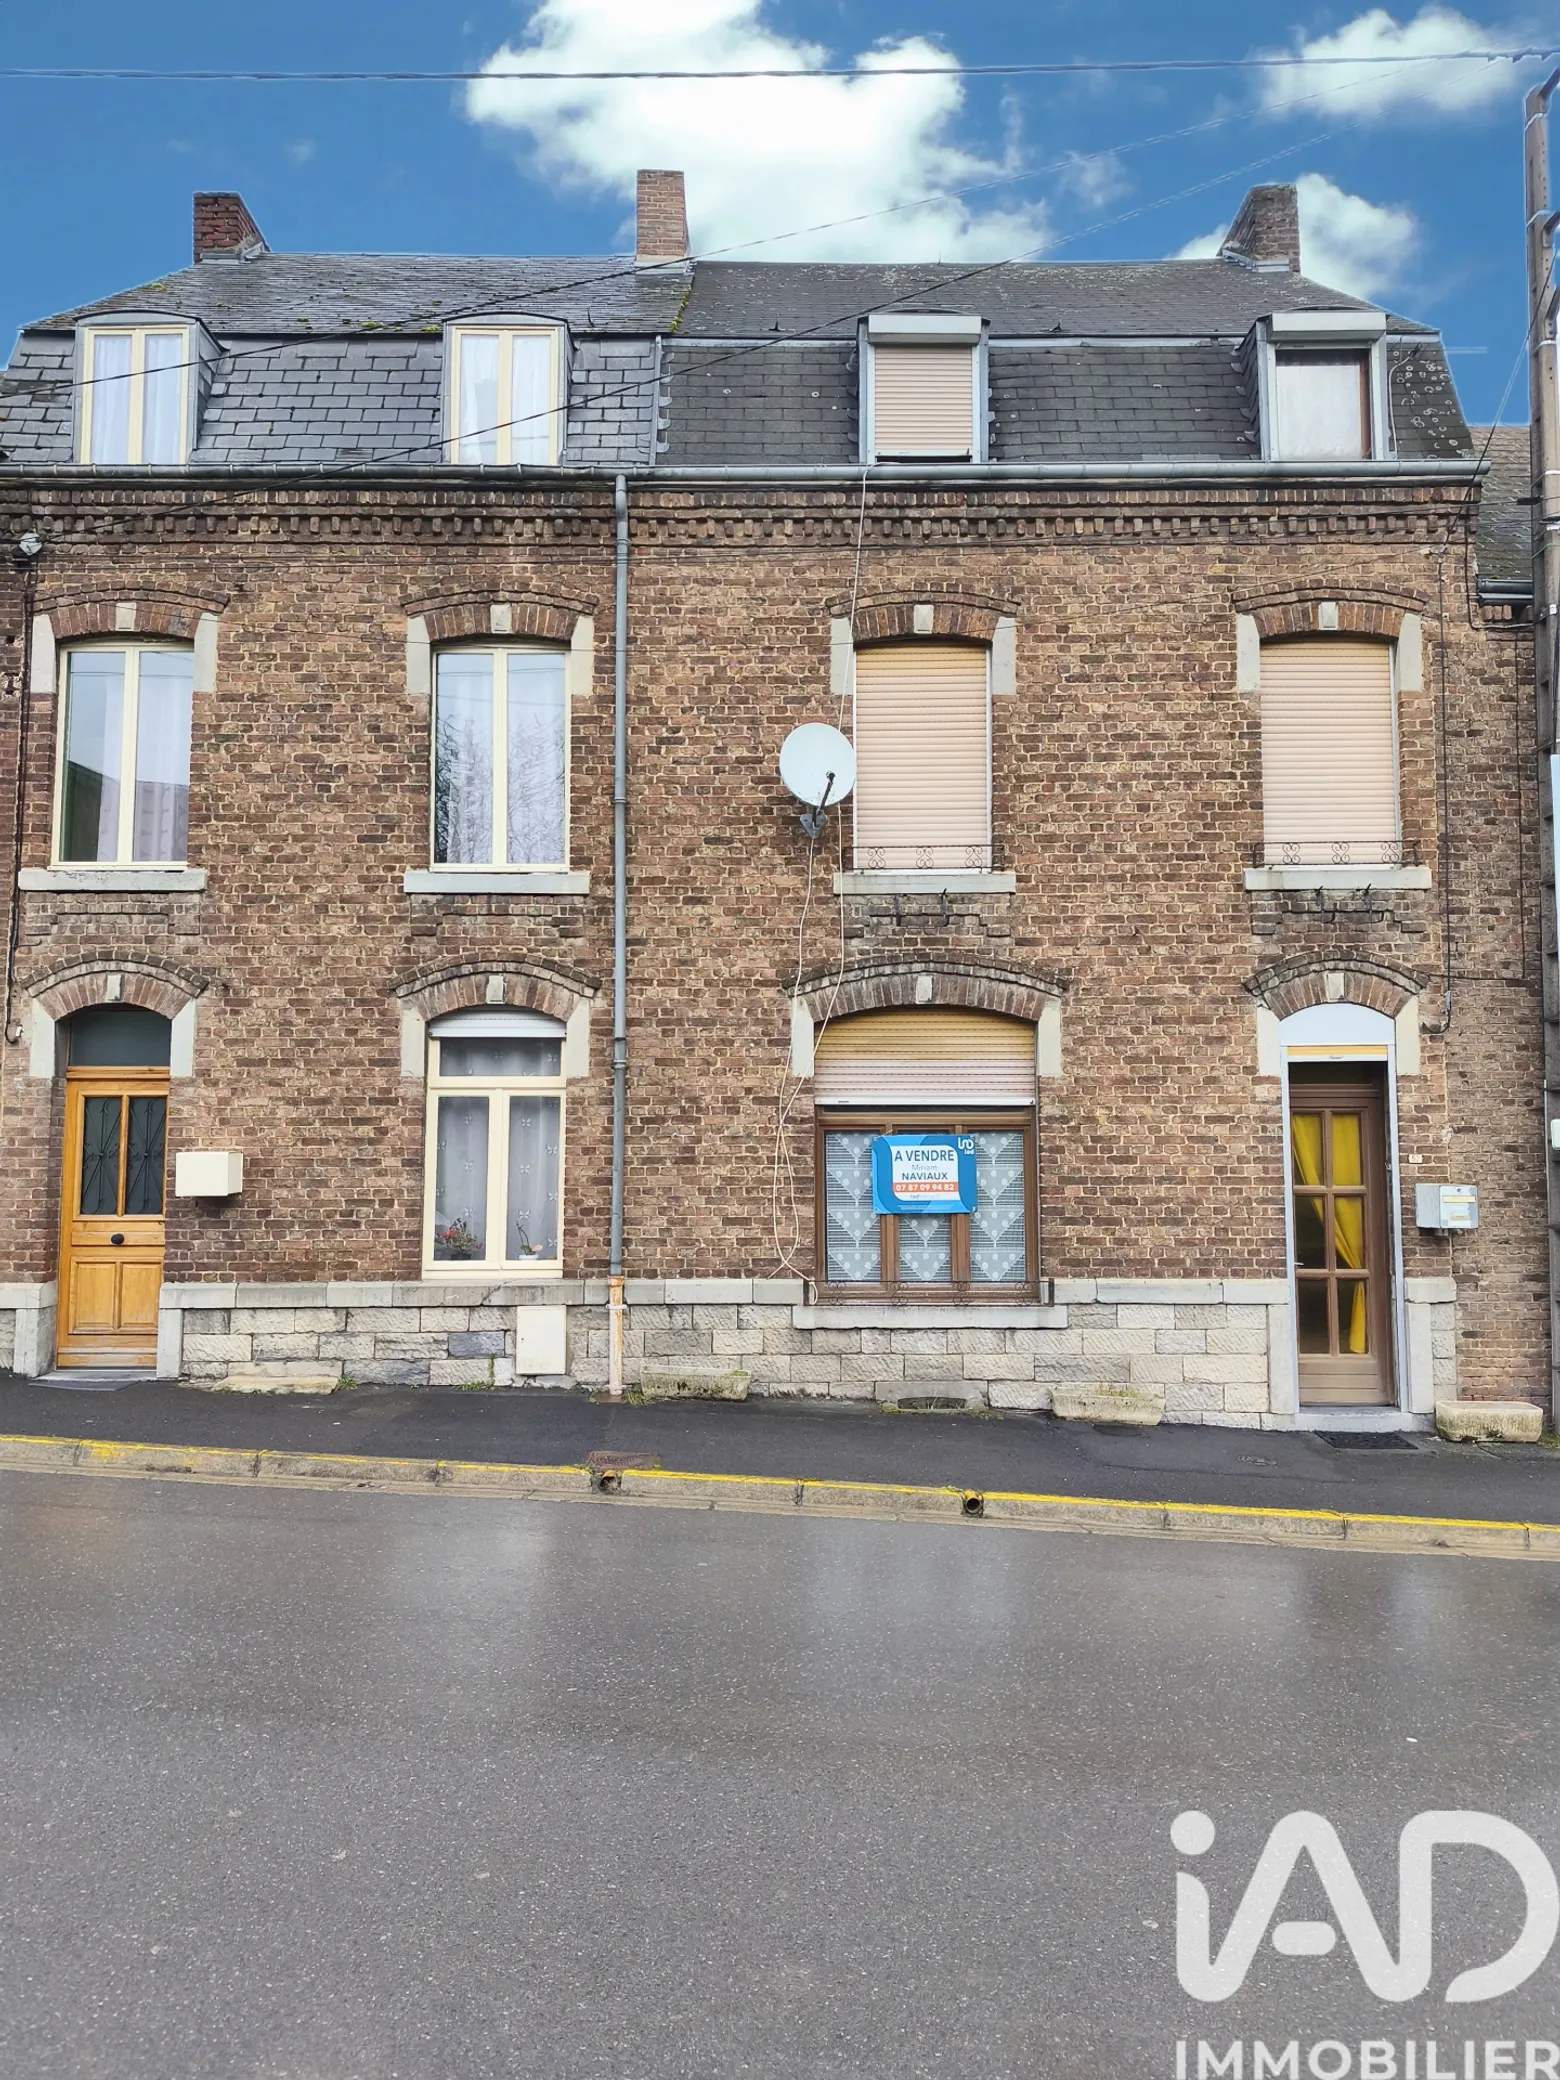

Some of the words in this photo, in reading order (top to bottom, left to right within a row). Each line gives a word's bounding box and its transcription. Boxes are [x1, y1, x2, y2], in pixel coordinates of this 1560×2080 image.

[894, 1150, 903, 1161] A
[906, 1150, 954, 1161] VENDRE
[902, 1172, 948, 1180] NAVIAUX
